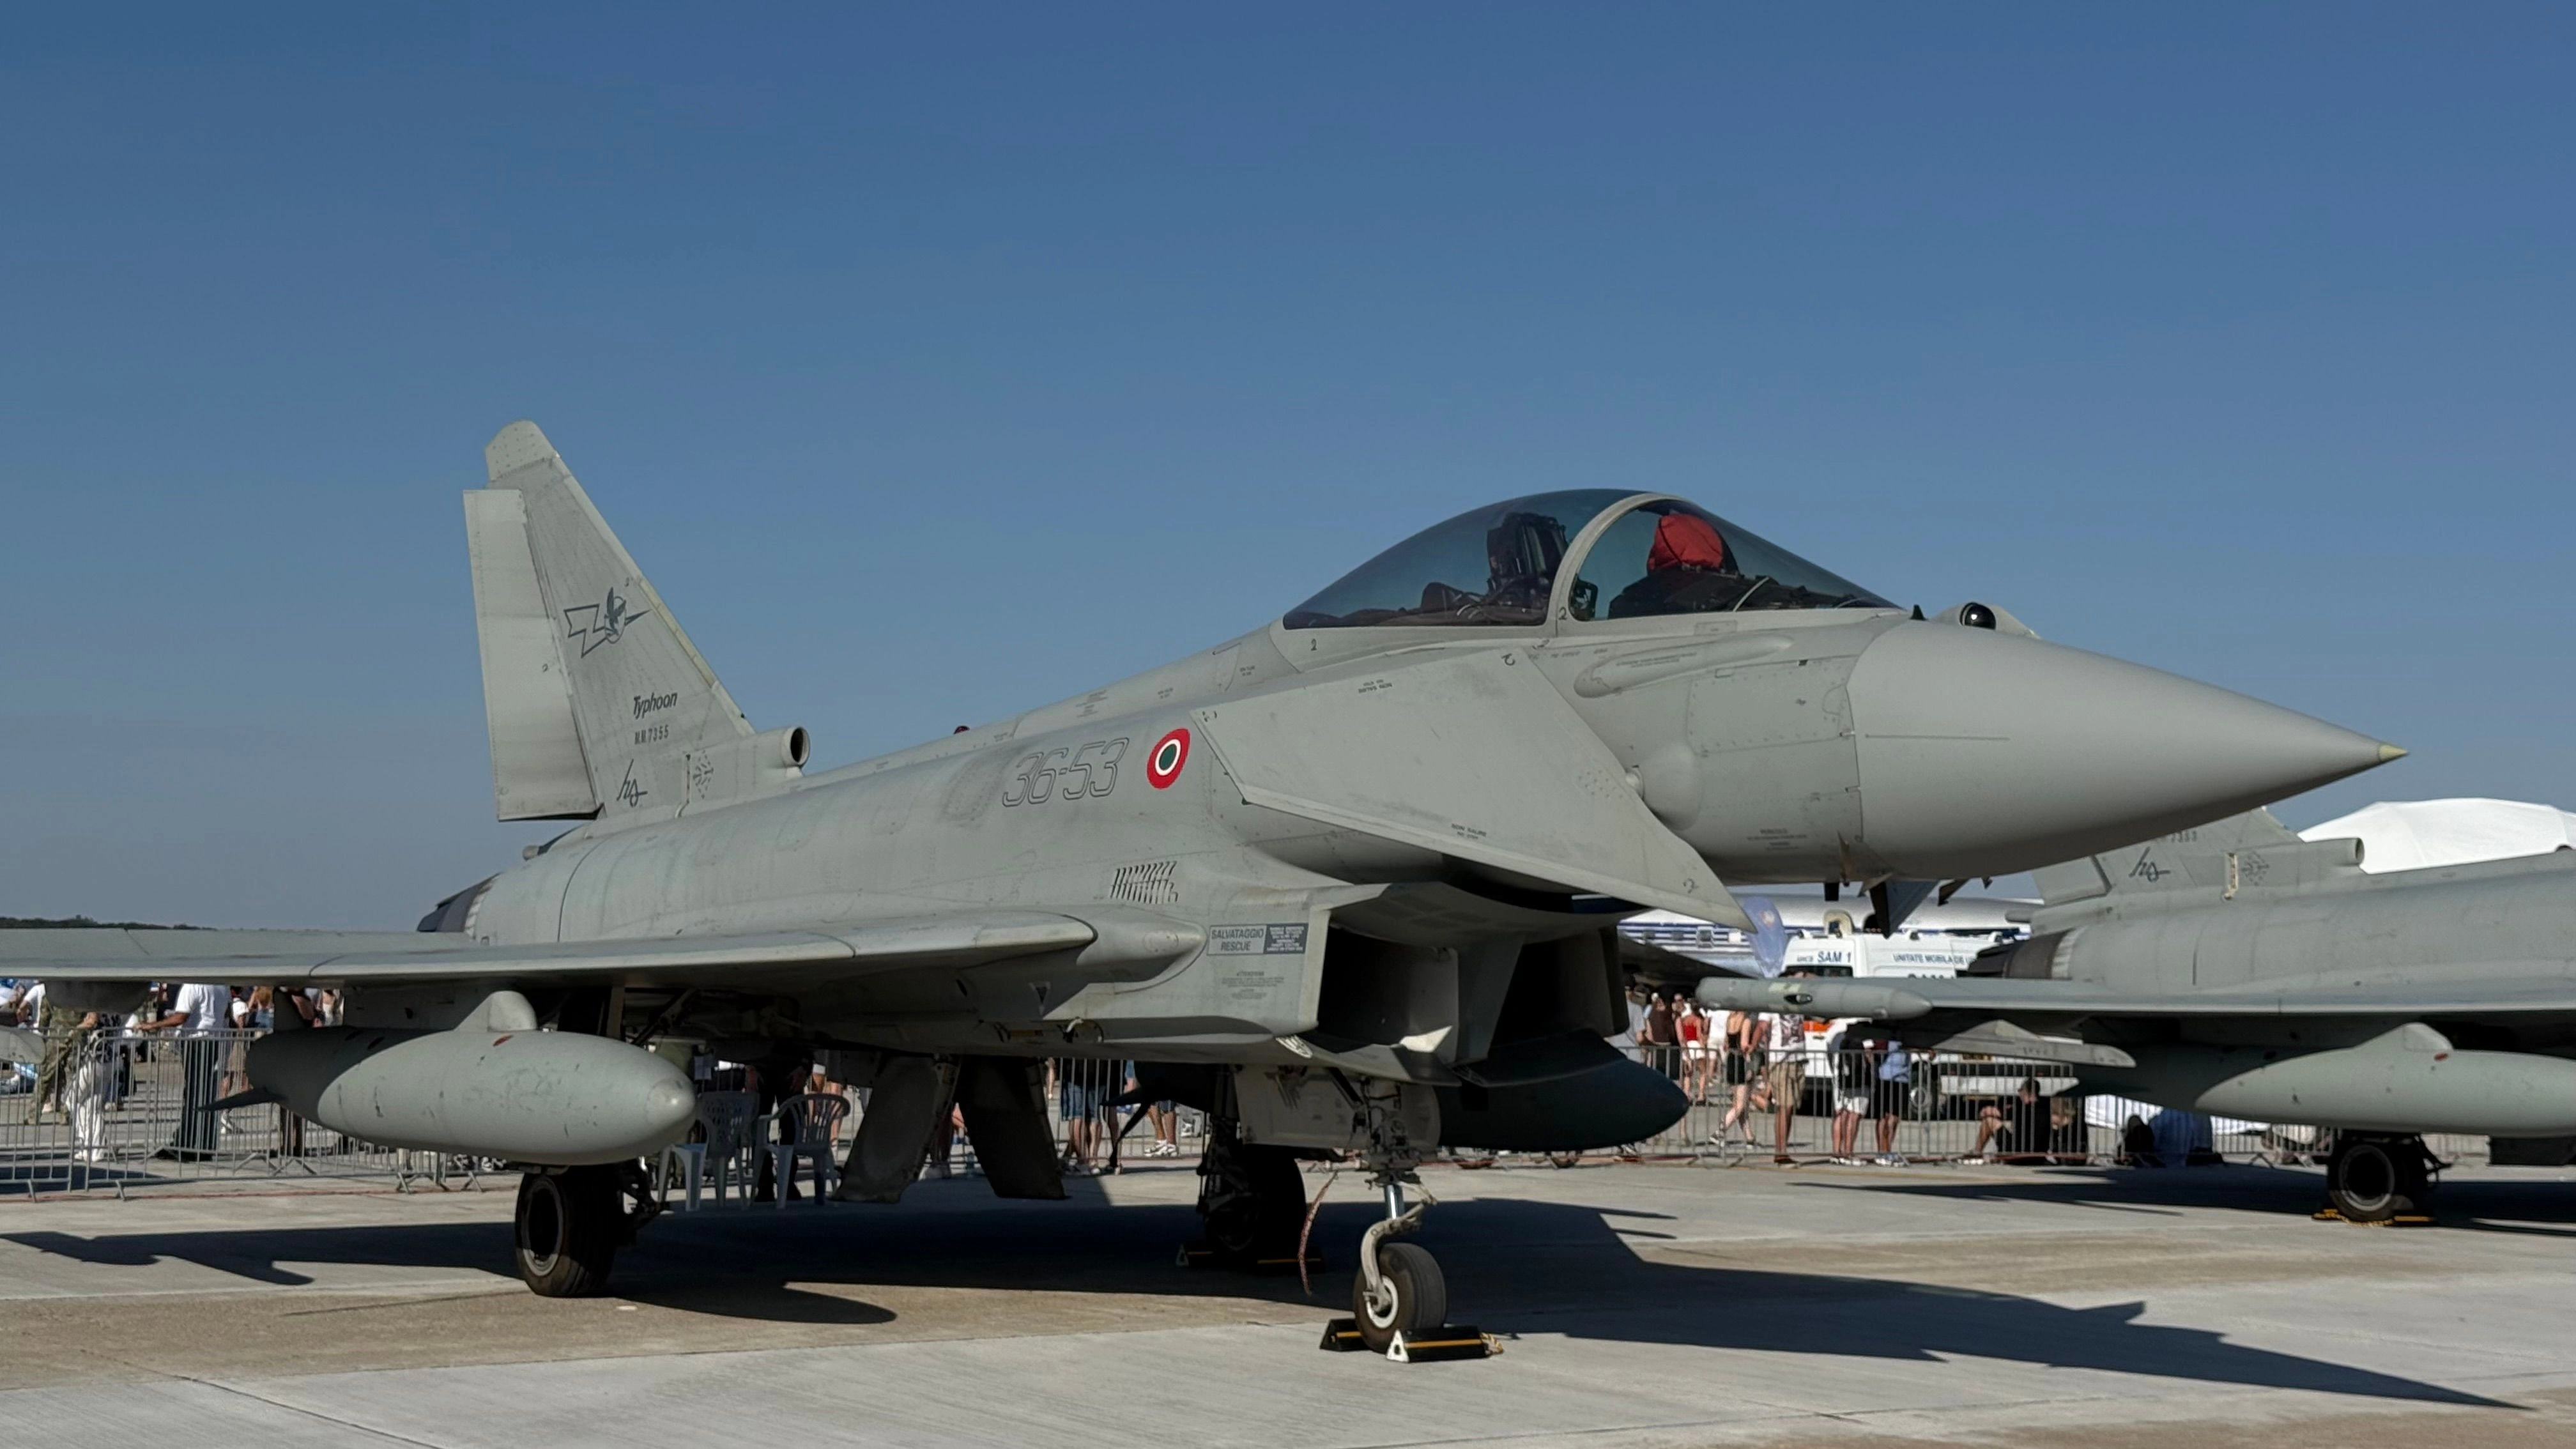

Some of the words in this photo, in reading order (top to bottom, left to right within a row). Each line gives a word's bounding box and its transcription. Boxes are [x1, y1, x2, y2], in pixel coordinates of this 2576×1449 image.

[633, 692, 678, 719] Typhoon
[1002, 737, 1130, 808] 36-53
[1211, 928, 1264, 940] SALVATAGGIO
[1220, 941, 1252, 951] RESCUE
[1817, 950, 1842, 963] SAM
